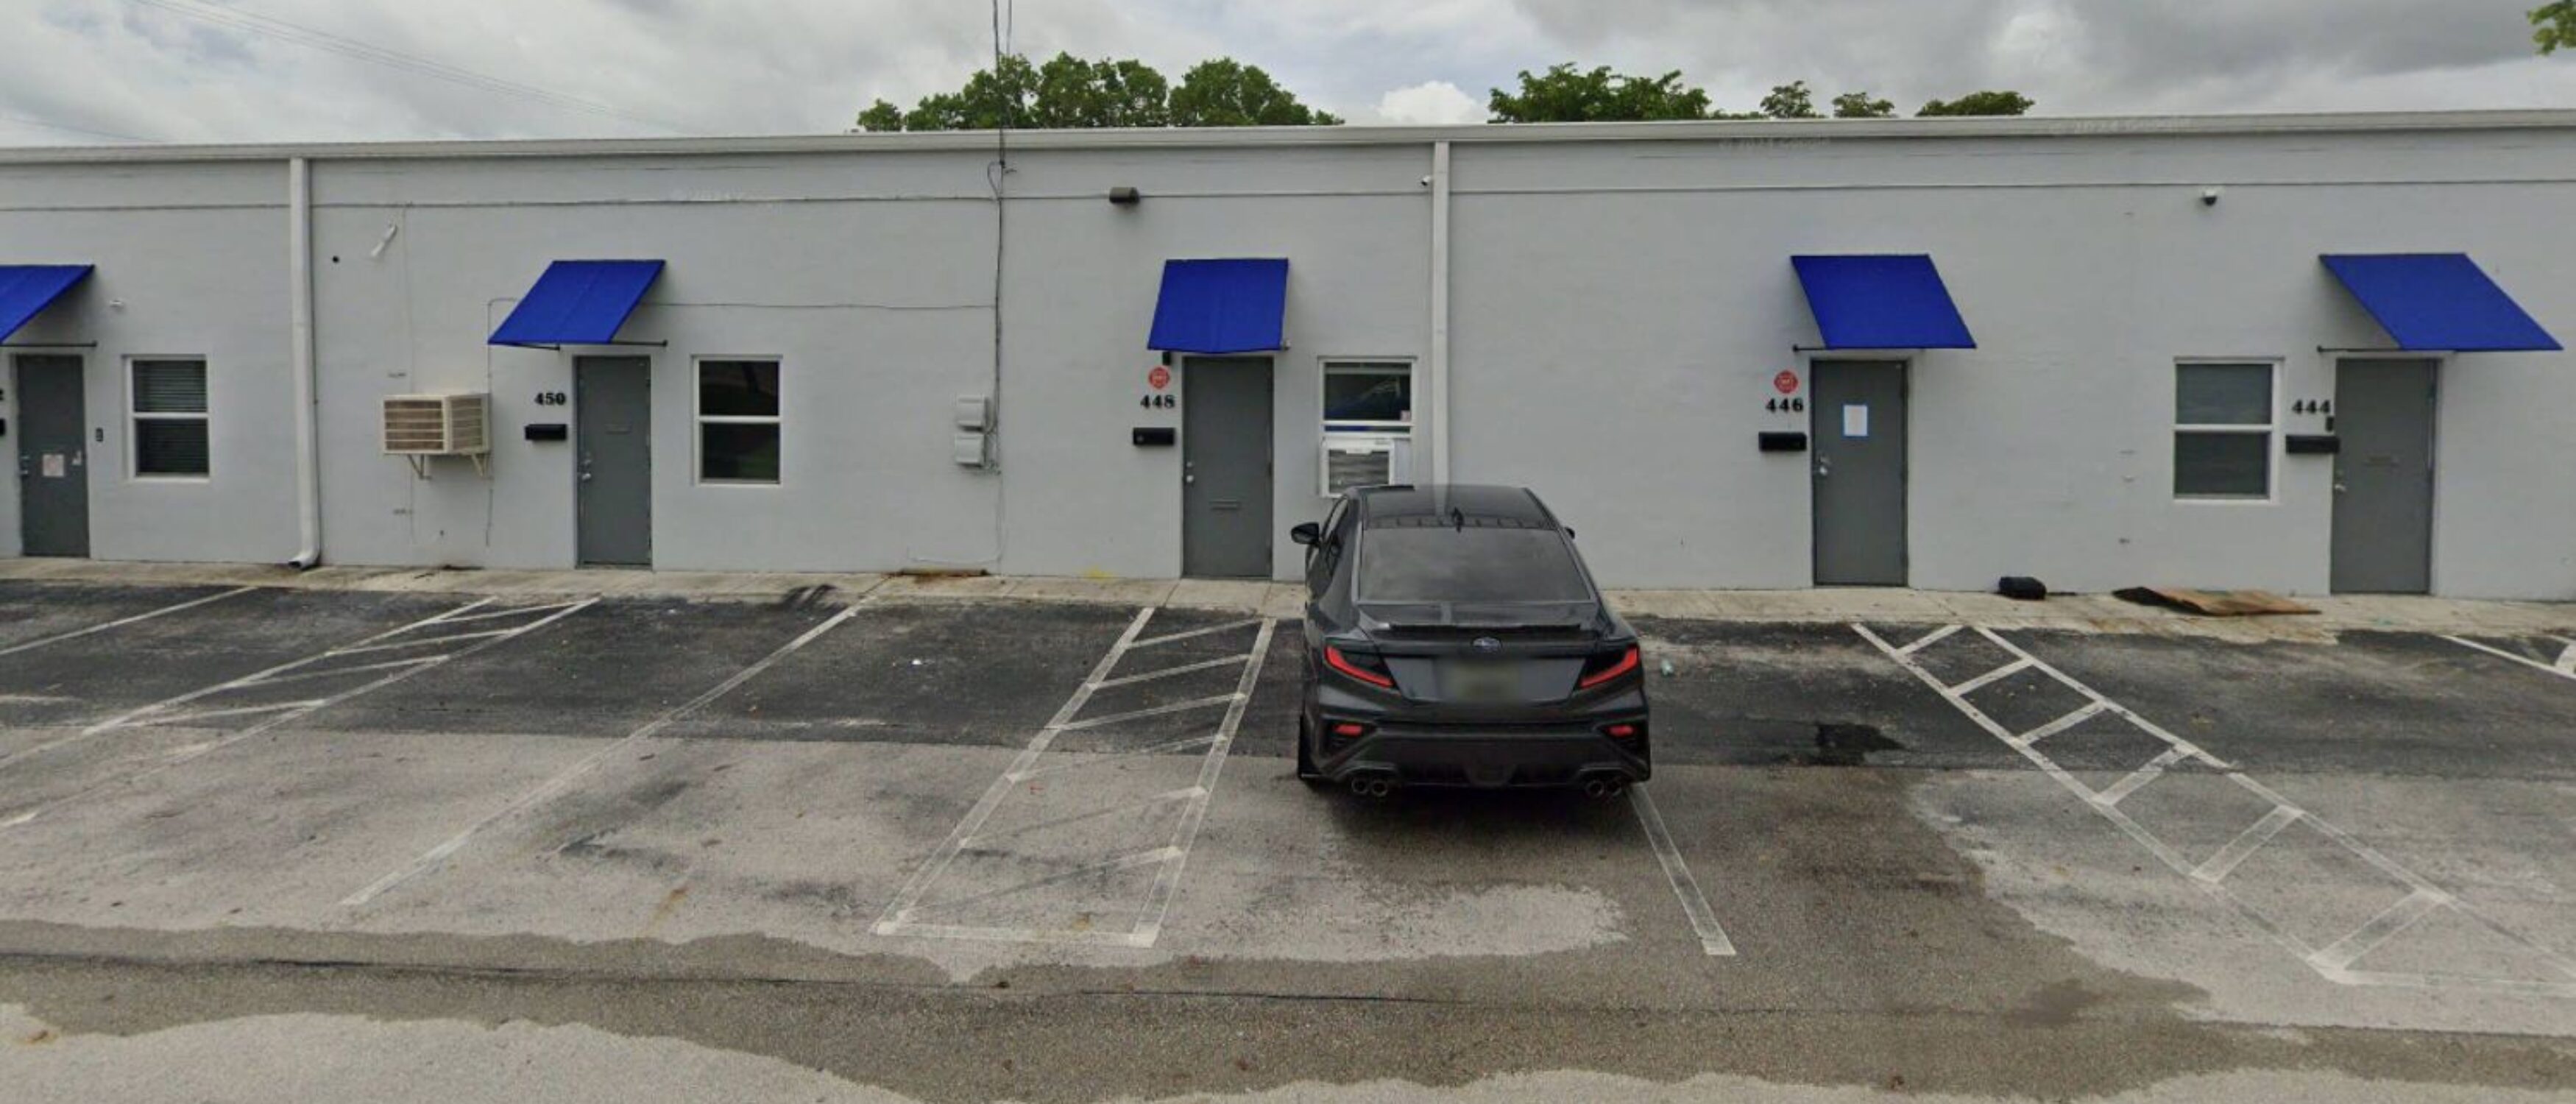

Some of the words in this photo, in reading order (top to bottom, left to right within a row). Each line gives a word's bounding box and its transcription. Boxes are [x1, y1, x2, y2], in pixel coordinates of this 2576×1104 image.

[534, 392, 566, 406] 450
[1140, 394, 1175, 409] 448
[1765, 397, 1803, 413] 446
[2290, 399, 2330, 414] 444
